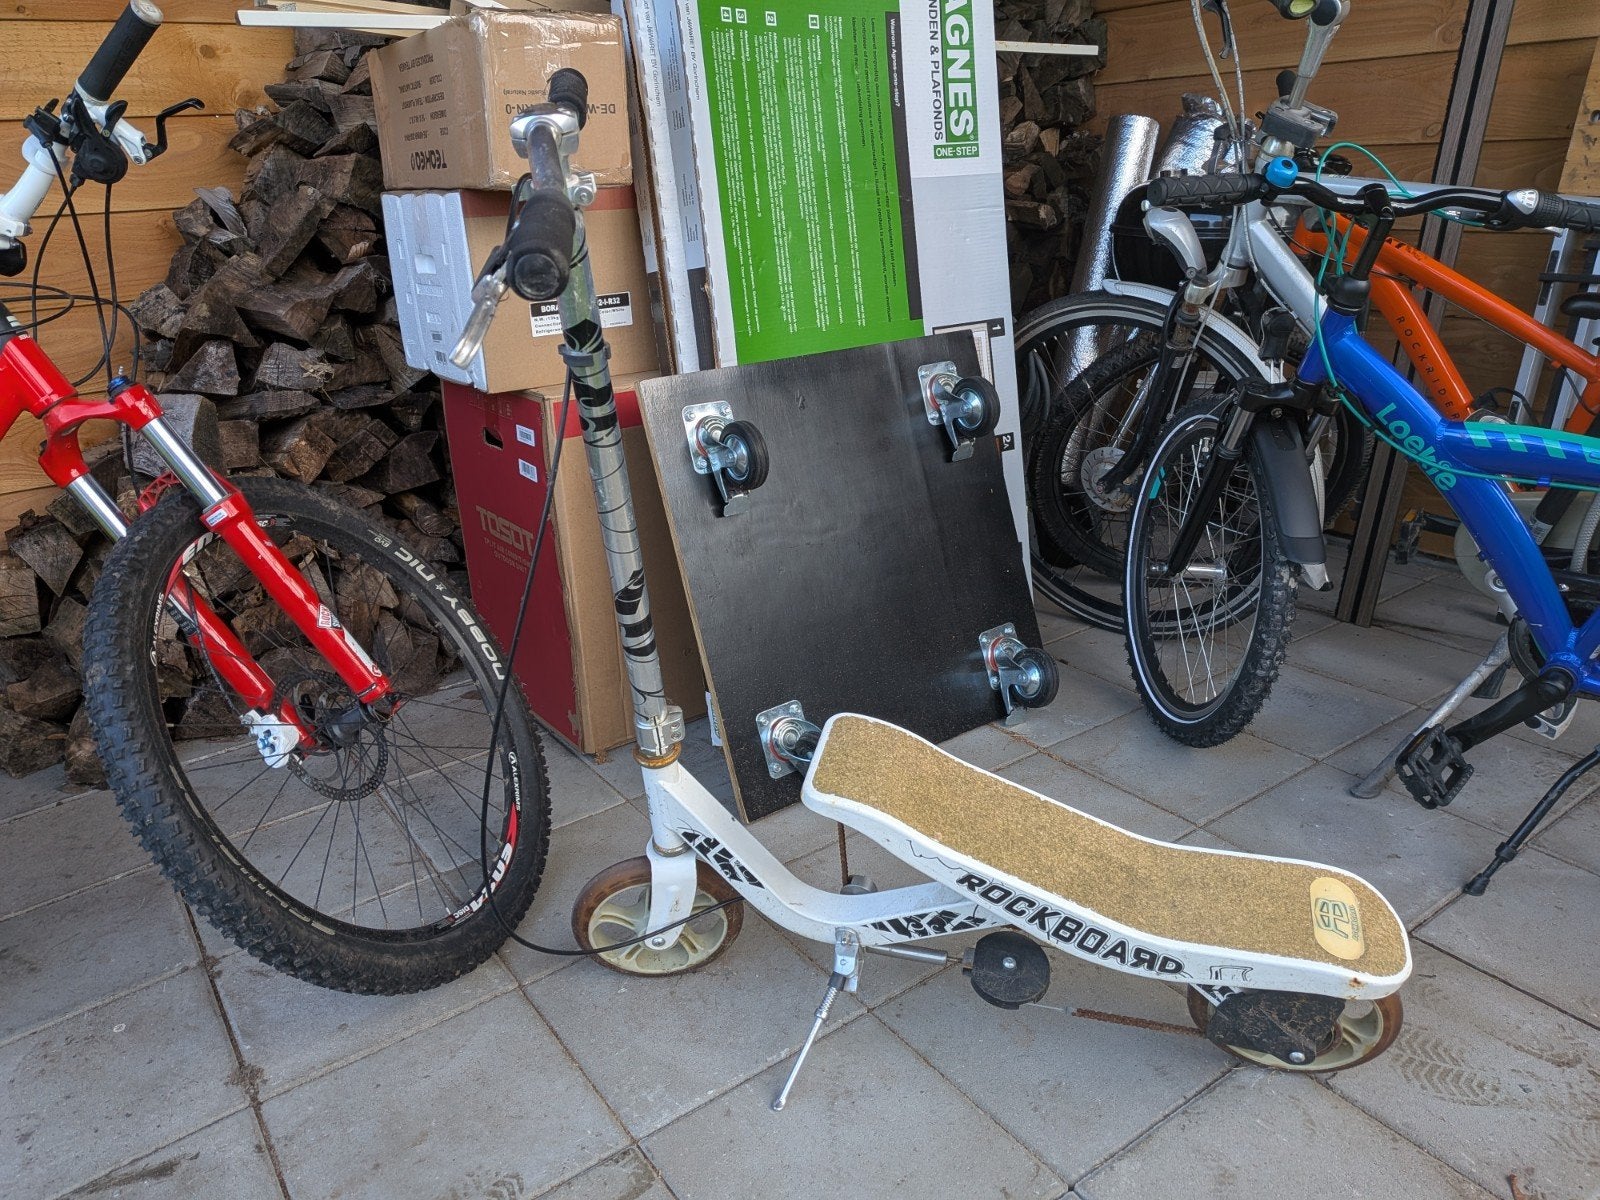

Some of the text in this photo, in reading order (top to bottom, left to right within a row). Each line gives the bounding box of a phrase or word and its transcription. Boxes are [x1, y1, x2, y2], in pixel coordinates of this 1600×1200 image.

[930, 45, 940, 56] &
[653, 70, 662, 106] Gorinchem
[692, 63, 700, 100] Gorinchem
[930, 60, 944, 141] PLAFONDS
[936, 146, 978, 157] ONE-STEP
[1396, 316, 1461, 420] ROCKRIDER
[1376, 403, 1456, 491] Loekie
[476, 505, 534, 557] TOSOT
[394, 547, 506, 681] NOBBY NIC
[453, 905, 470, 918] DISC
